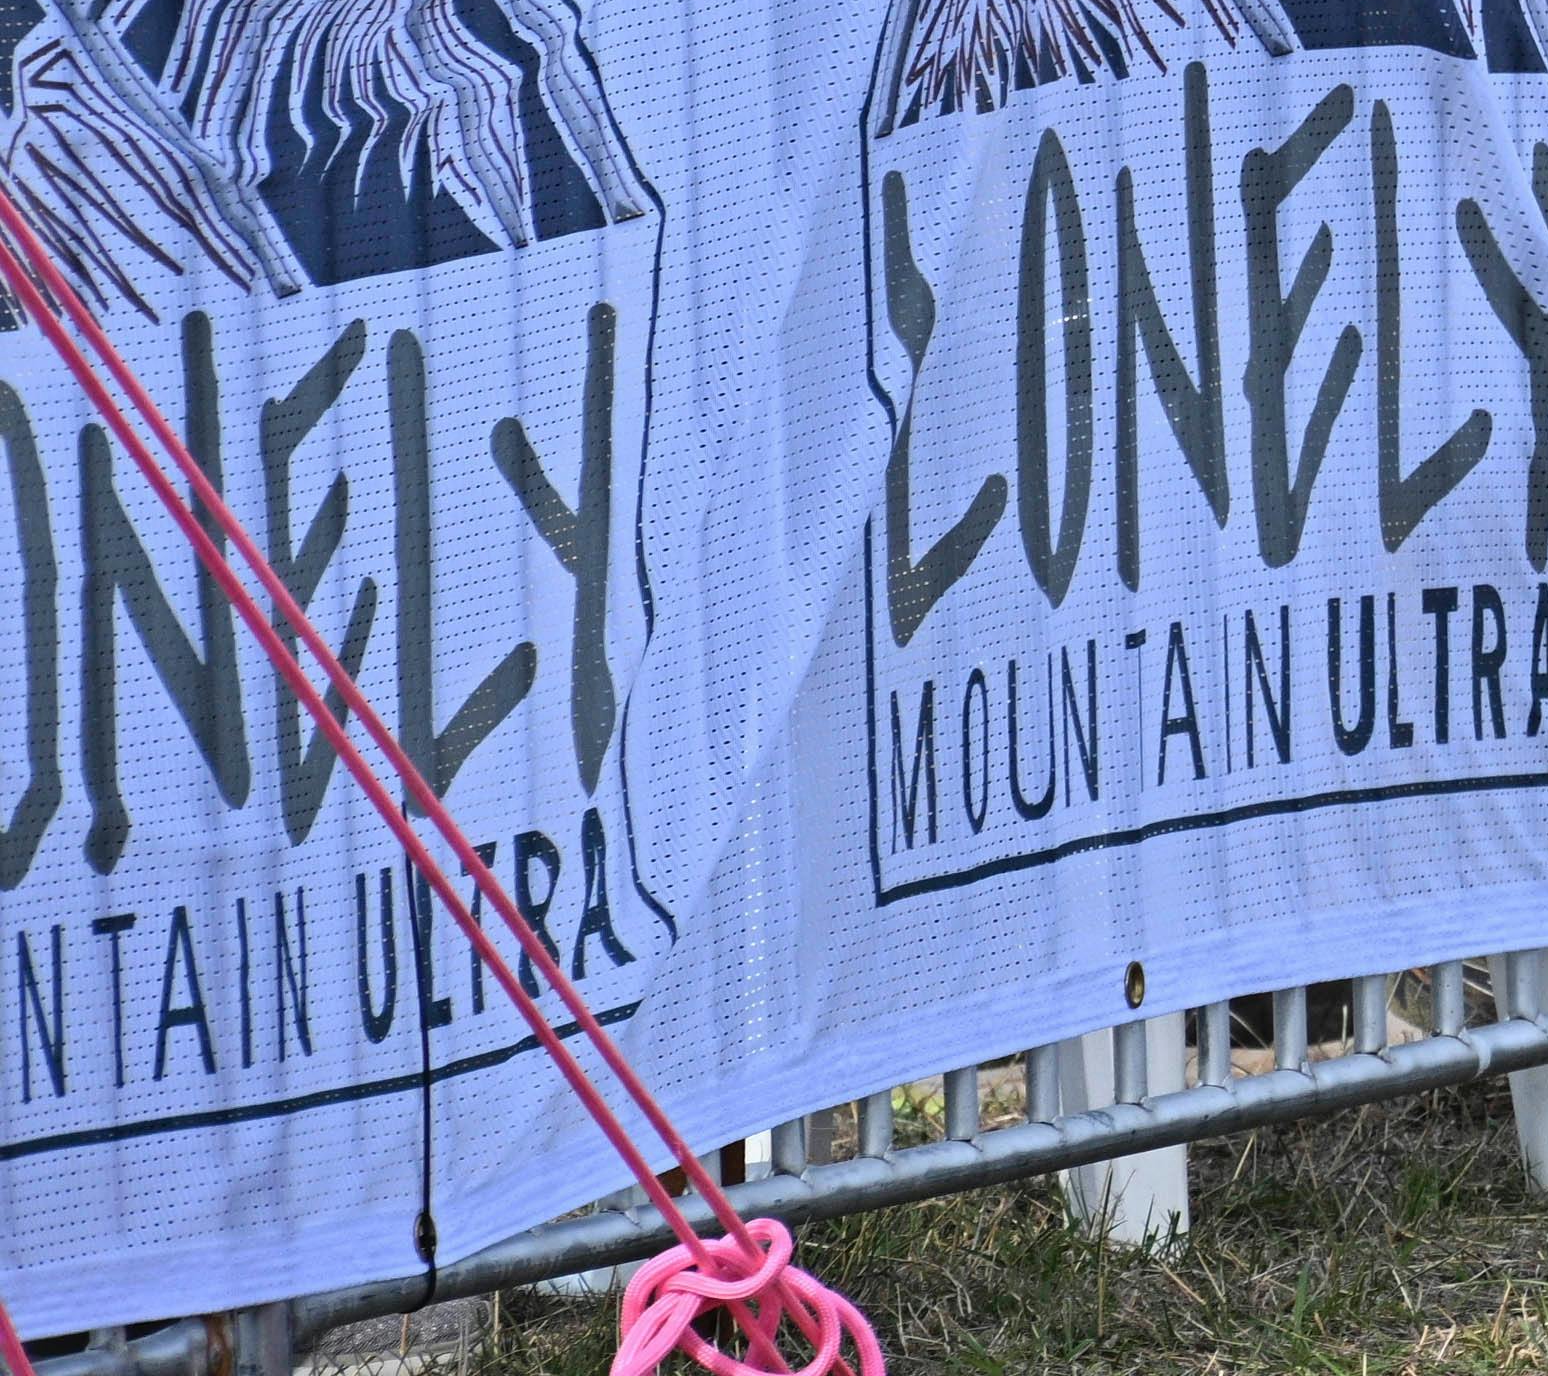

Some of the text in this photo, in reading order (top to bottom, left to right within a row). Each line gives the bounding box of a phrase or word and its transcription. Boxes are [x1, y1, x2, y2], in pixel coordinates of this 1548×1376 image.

[0, 302, 618, 889] ONELY
[889, 605, 1292, 855] MOUNTAIN
[17, 807, 637, 1103] NTAIN ULTRA
